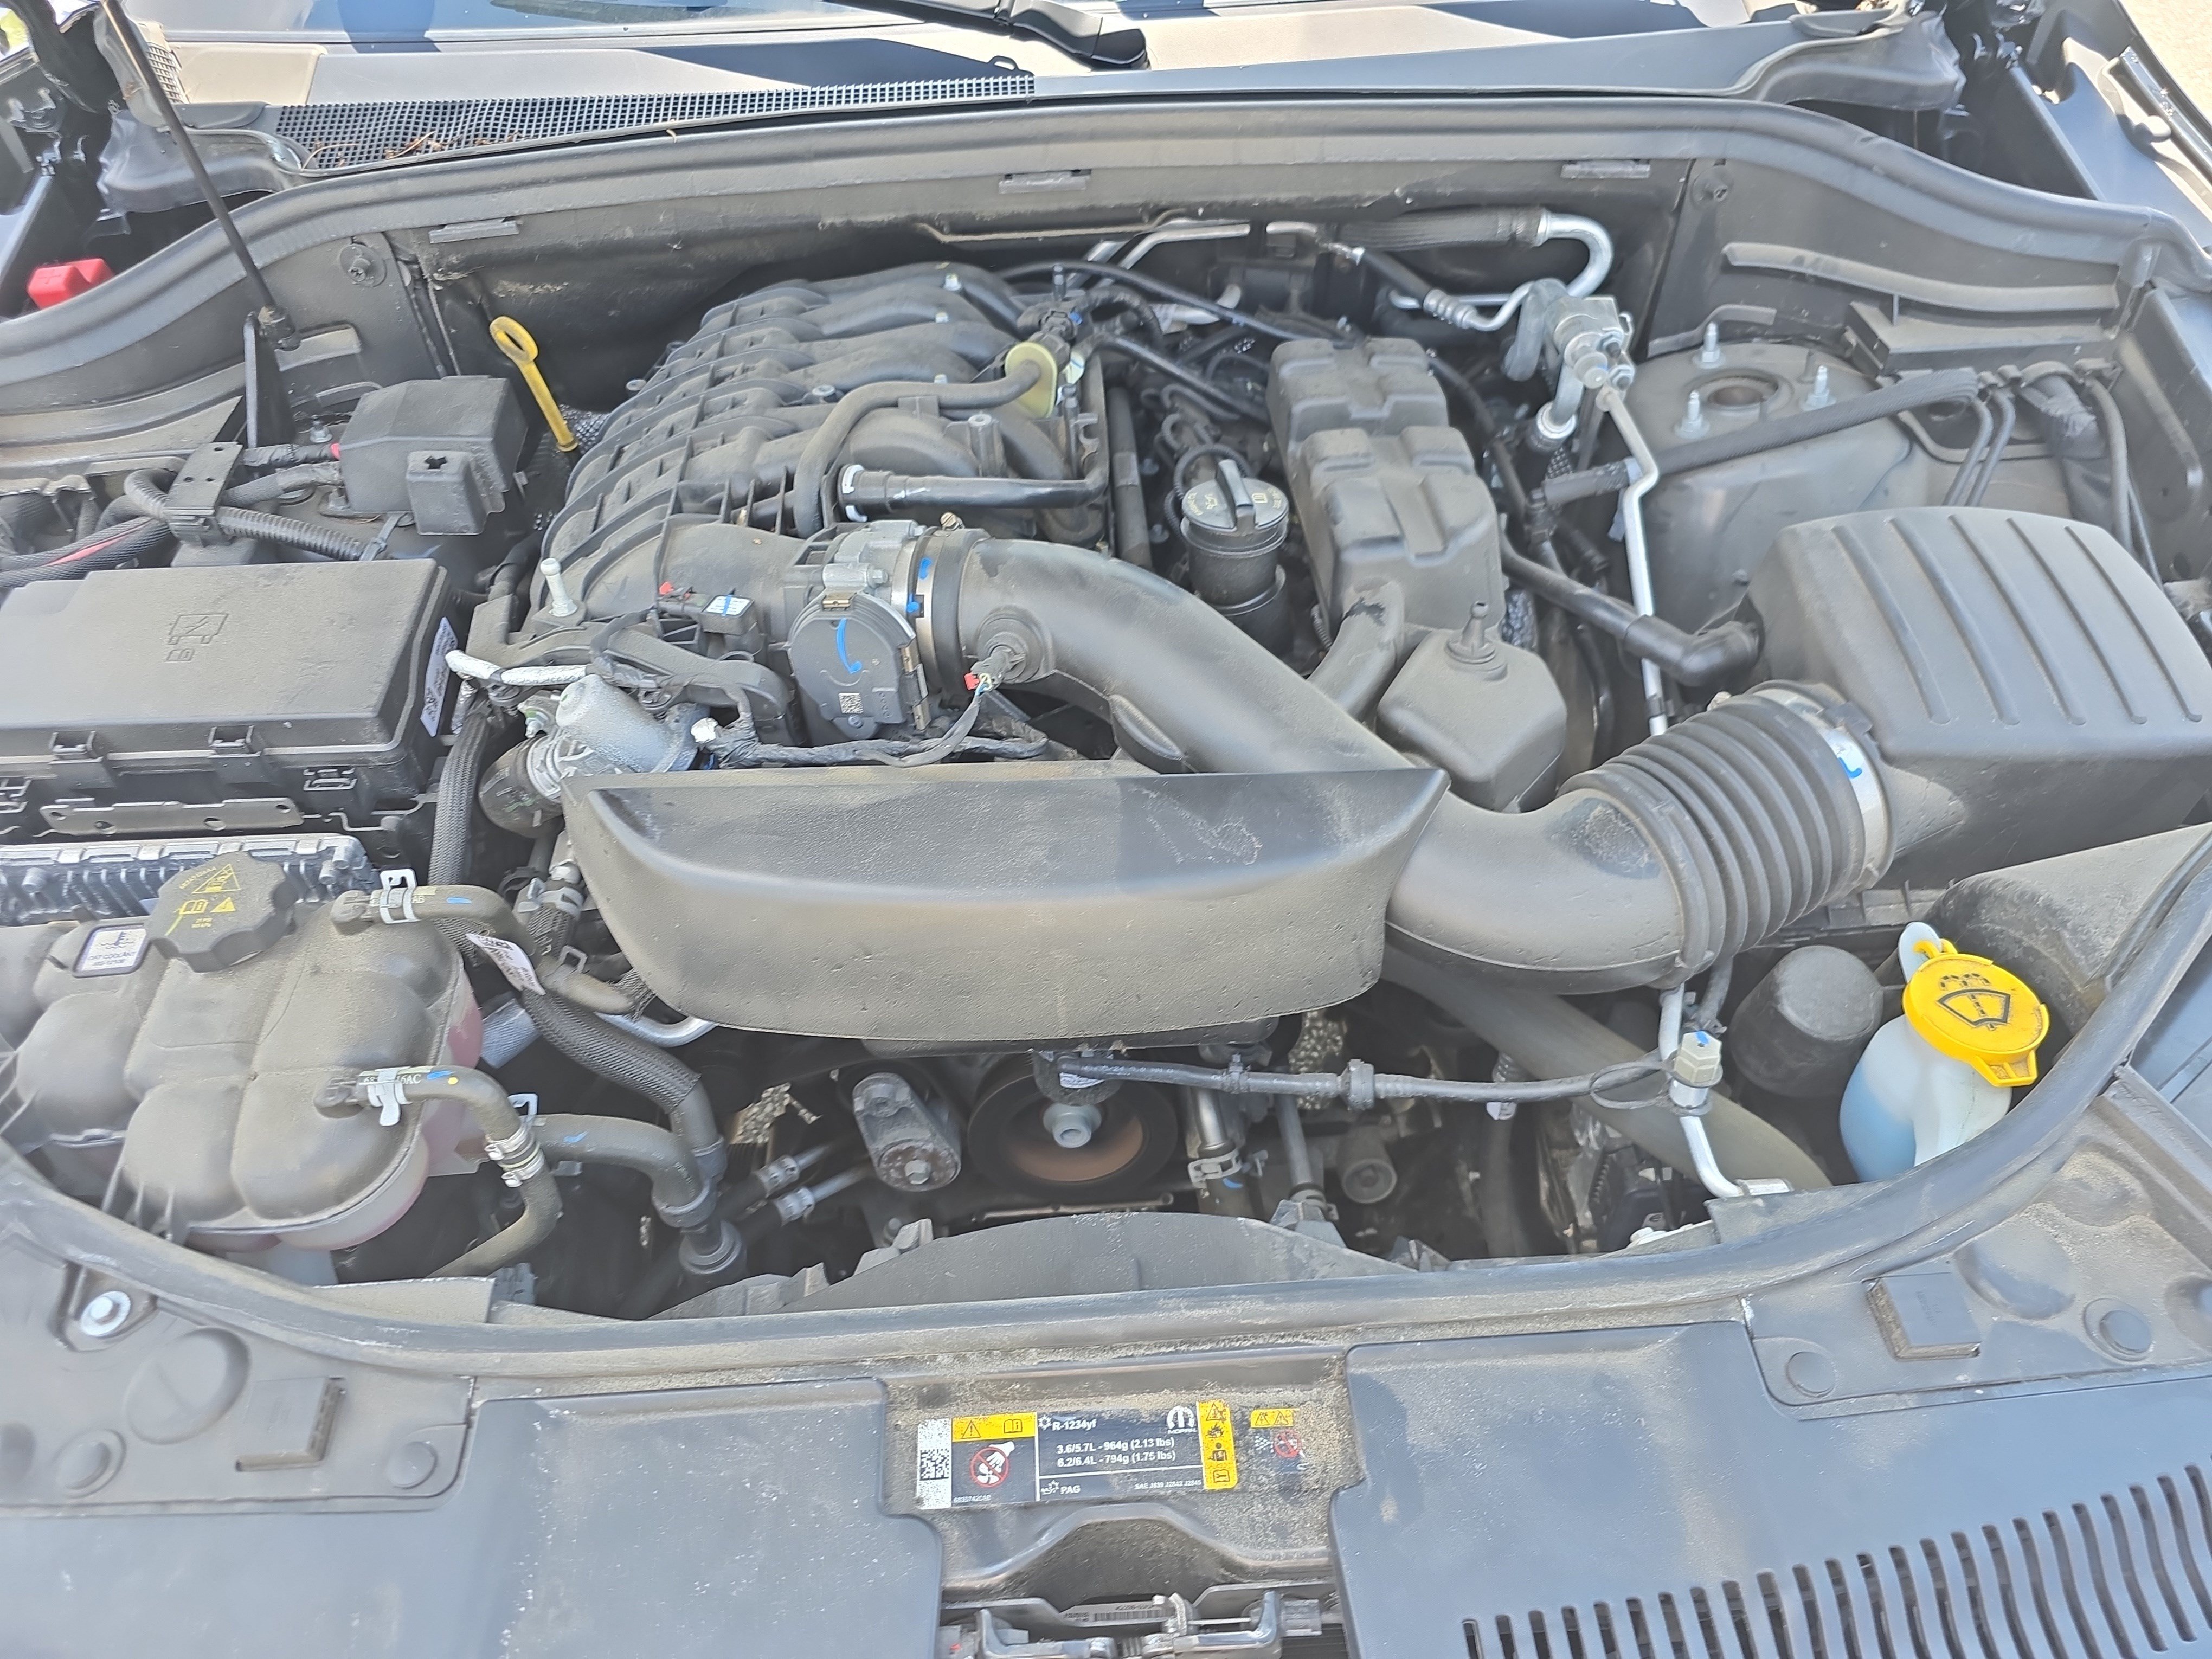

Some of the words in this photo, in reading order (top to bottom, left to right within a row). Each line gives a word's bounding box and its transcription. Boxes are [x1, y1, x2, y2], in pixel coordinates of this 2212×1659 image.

[1052, 1418, 1097, 1431] R-1234yf
[1056, 1442, 1097, 1454] 3.6/5.7L
[1103, 1440, 1129, 1451] 964g
[1131, 1438, 1155, 1451] (2.13
[1156, 1437, 1175, 1448] lbs)
[1057, 1456, 1097, 1468] 6.2/6.4L
[1104, 1454, 1129, 1465] 794g
[1131, 1451, 1156, 1464] (1.75
[1157, 1450, 1176, 1461] lbs)
[1059, 1485, 1081, 1495] PAG
